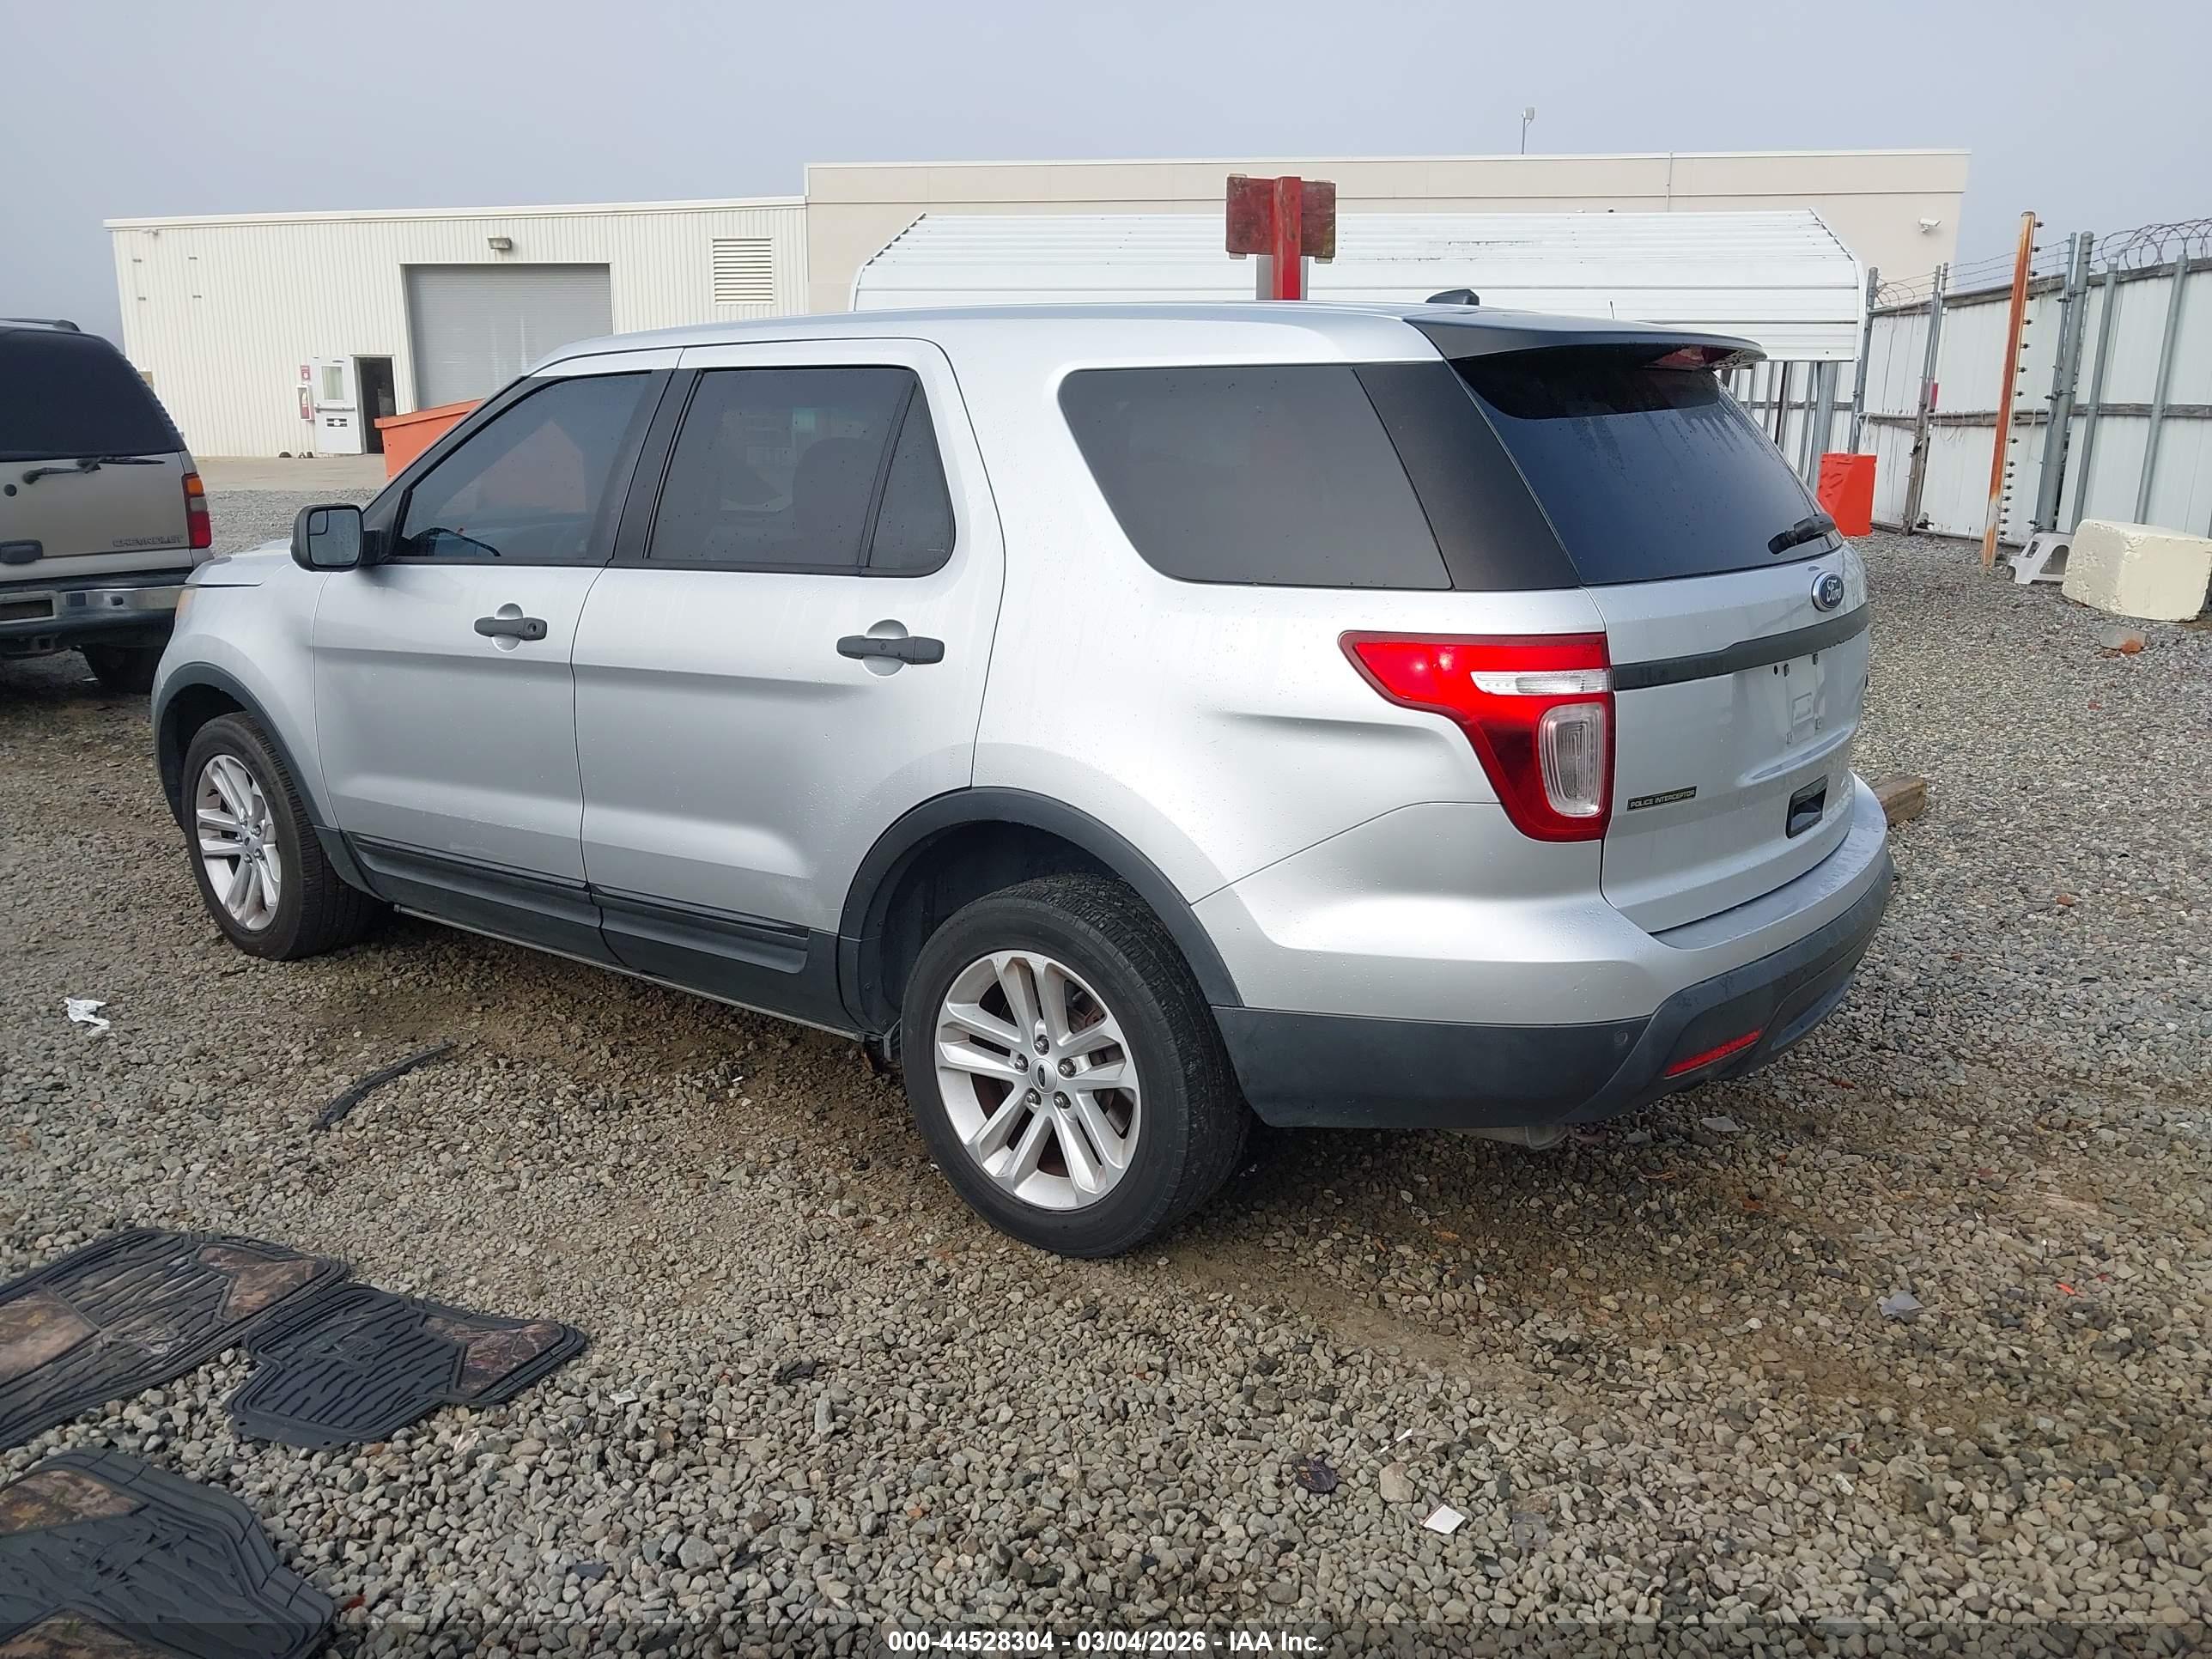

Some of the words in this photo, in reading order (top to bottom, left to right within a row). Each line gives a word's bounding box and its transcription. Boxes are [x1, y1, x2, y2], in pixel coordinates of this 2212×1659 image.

[112, 535, 183, 548] CHEVROLET
[1826, 579, 1843, 603] Ford
[1630, 798, 1654, 808] POLICE
[1654, 789, 1695, 804] INTERCEPTOR
